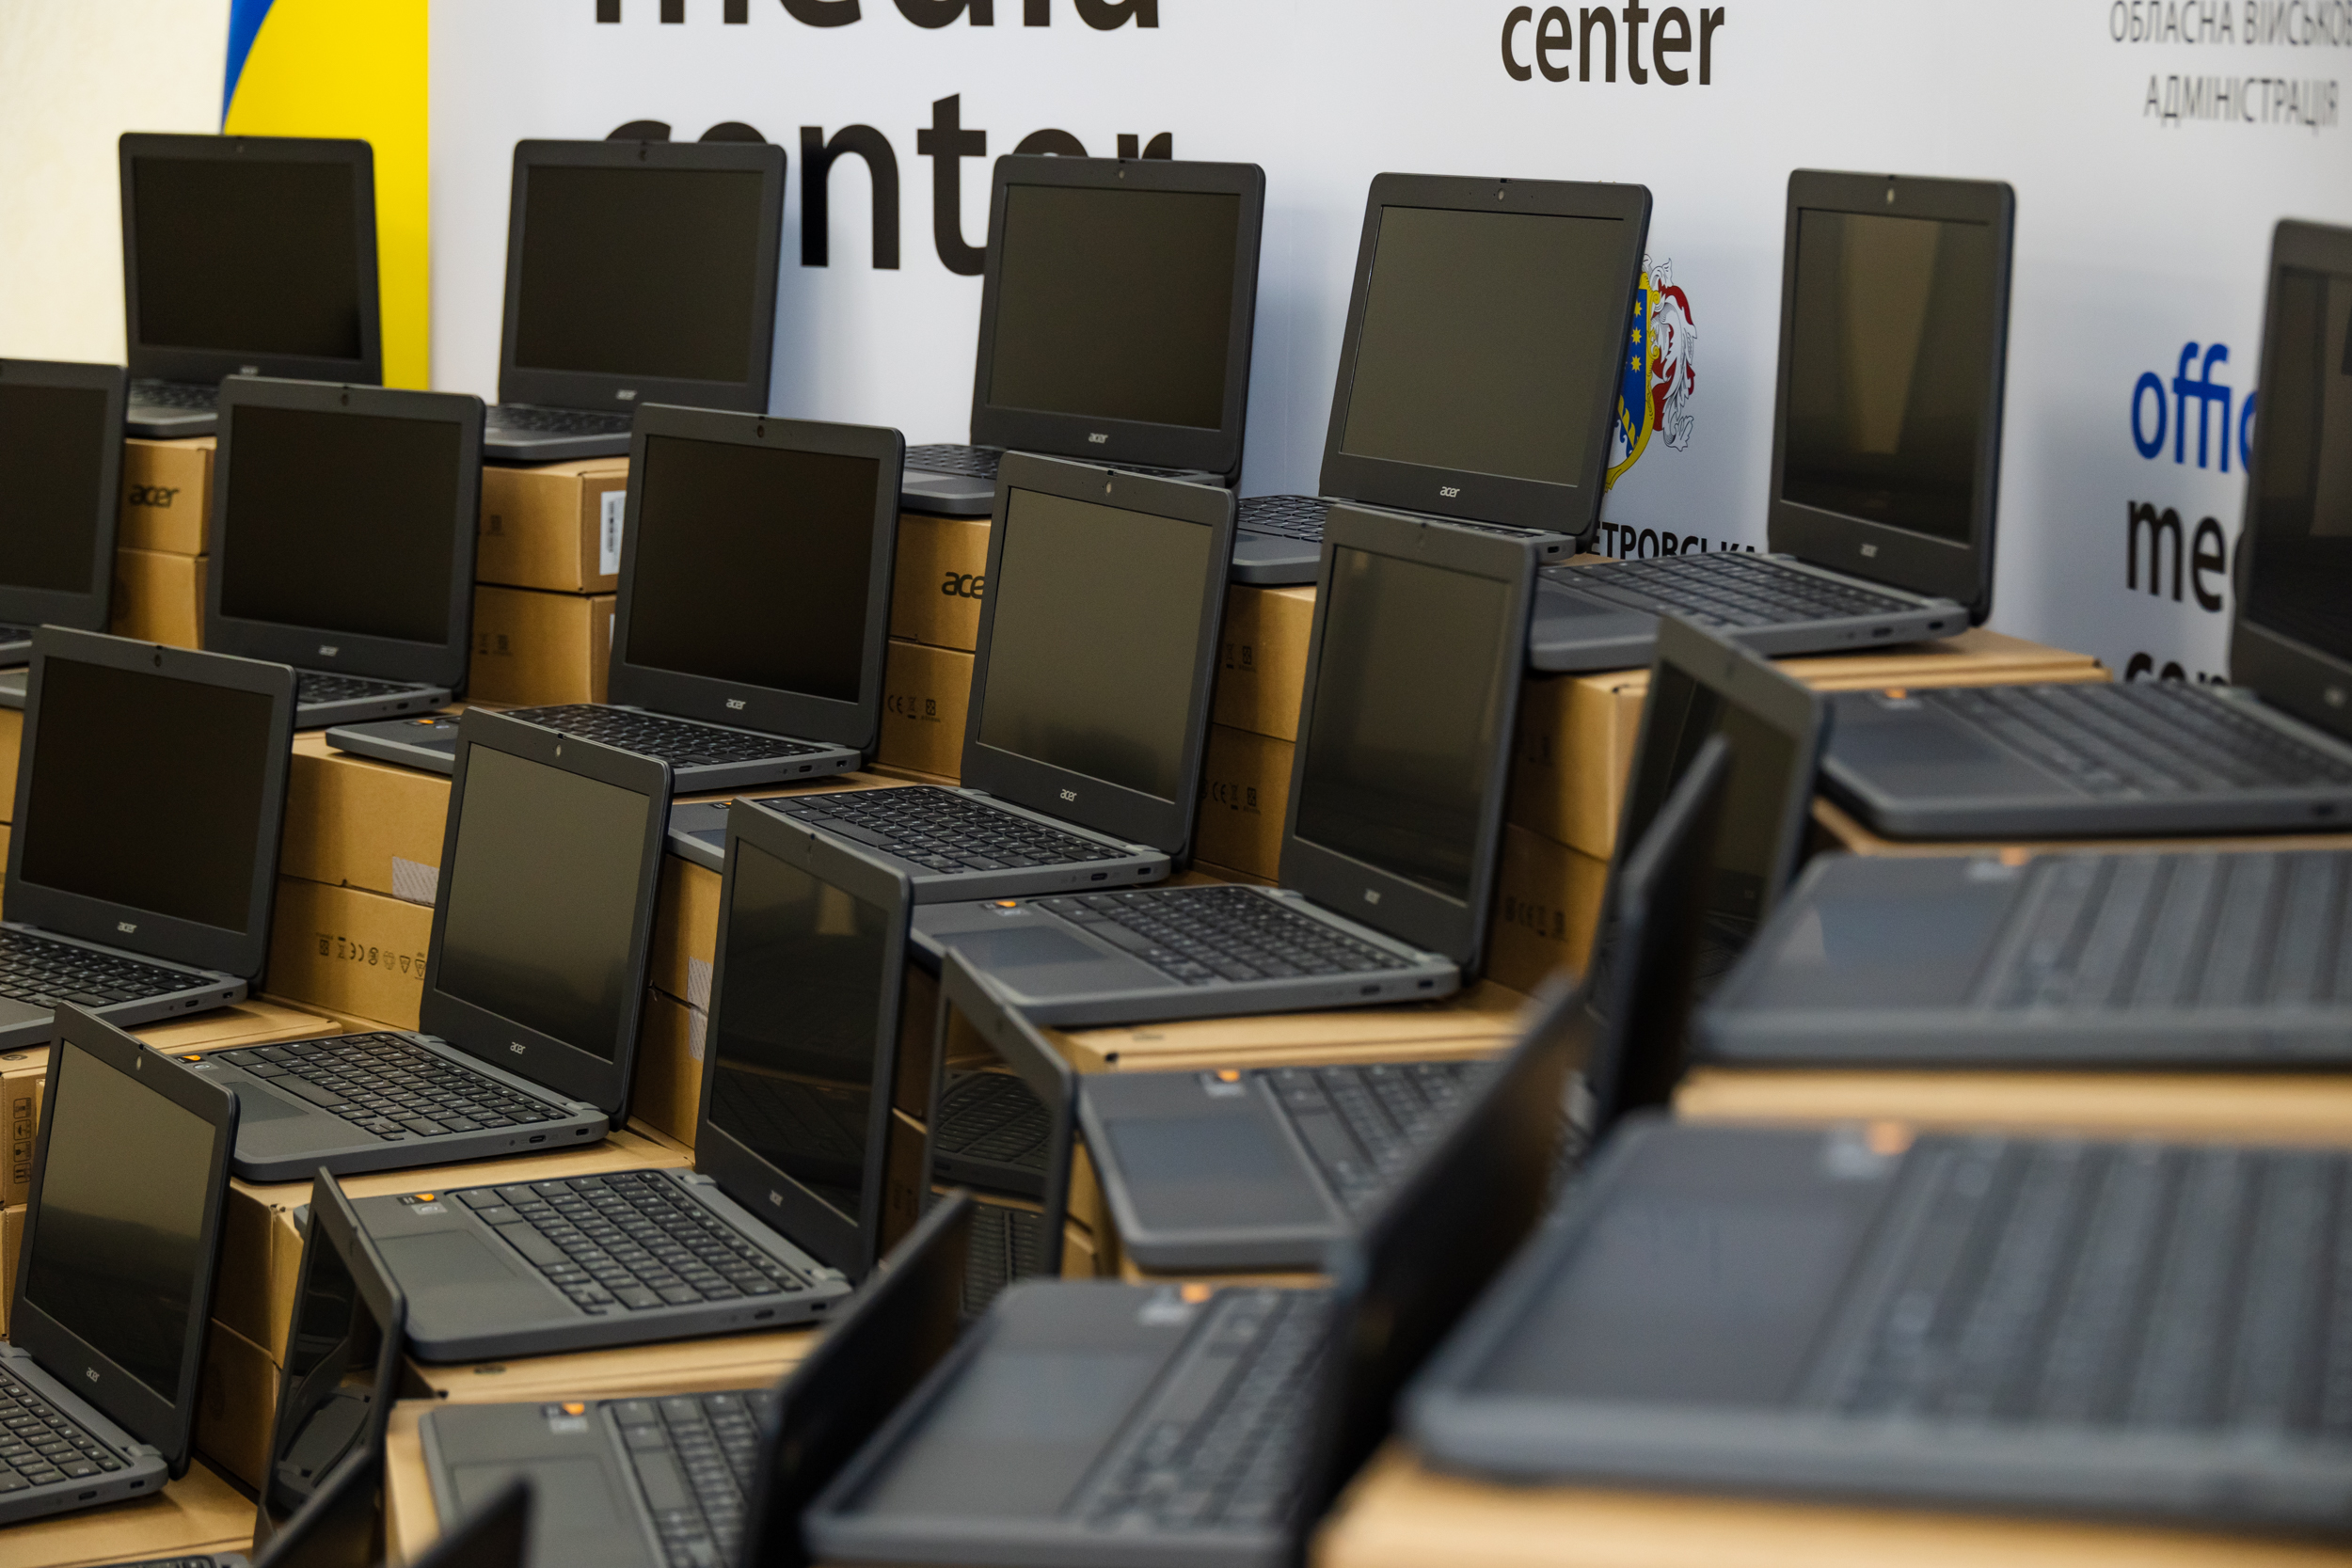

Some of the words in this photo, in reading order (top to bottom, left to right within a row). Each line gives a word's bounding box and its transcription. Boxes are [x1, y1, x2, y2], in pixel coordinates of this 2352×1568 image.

[2109, 0, 2235, 44] ОБЛАСНА
[1502, 0, 1724, 86] center
[129, 483, 181, 509] acer
[1439, 485, 1461, 499] acer
[2127, 500, 2227, 612] me
[942, 572, 985, 599] ace
[725, 698, 747, 710] acer
[1059, 788, 1078, 802] acer
[117, 921, 137, 934] acer
[509, 1041, 527, 1055] acer
